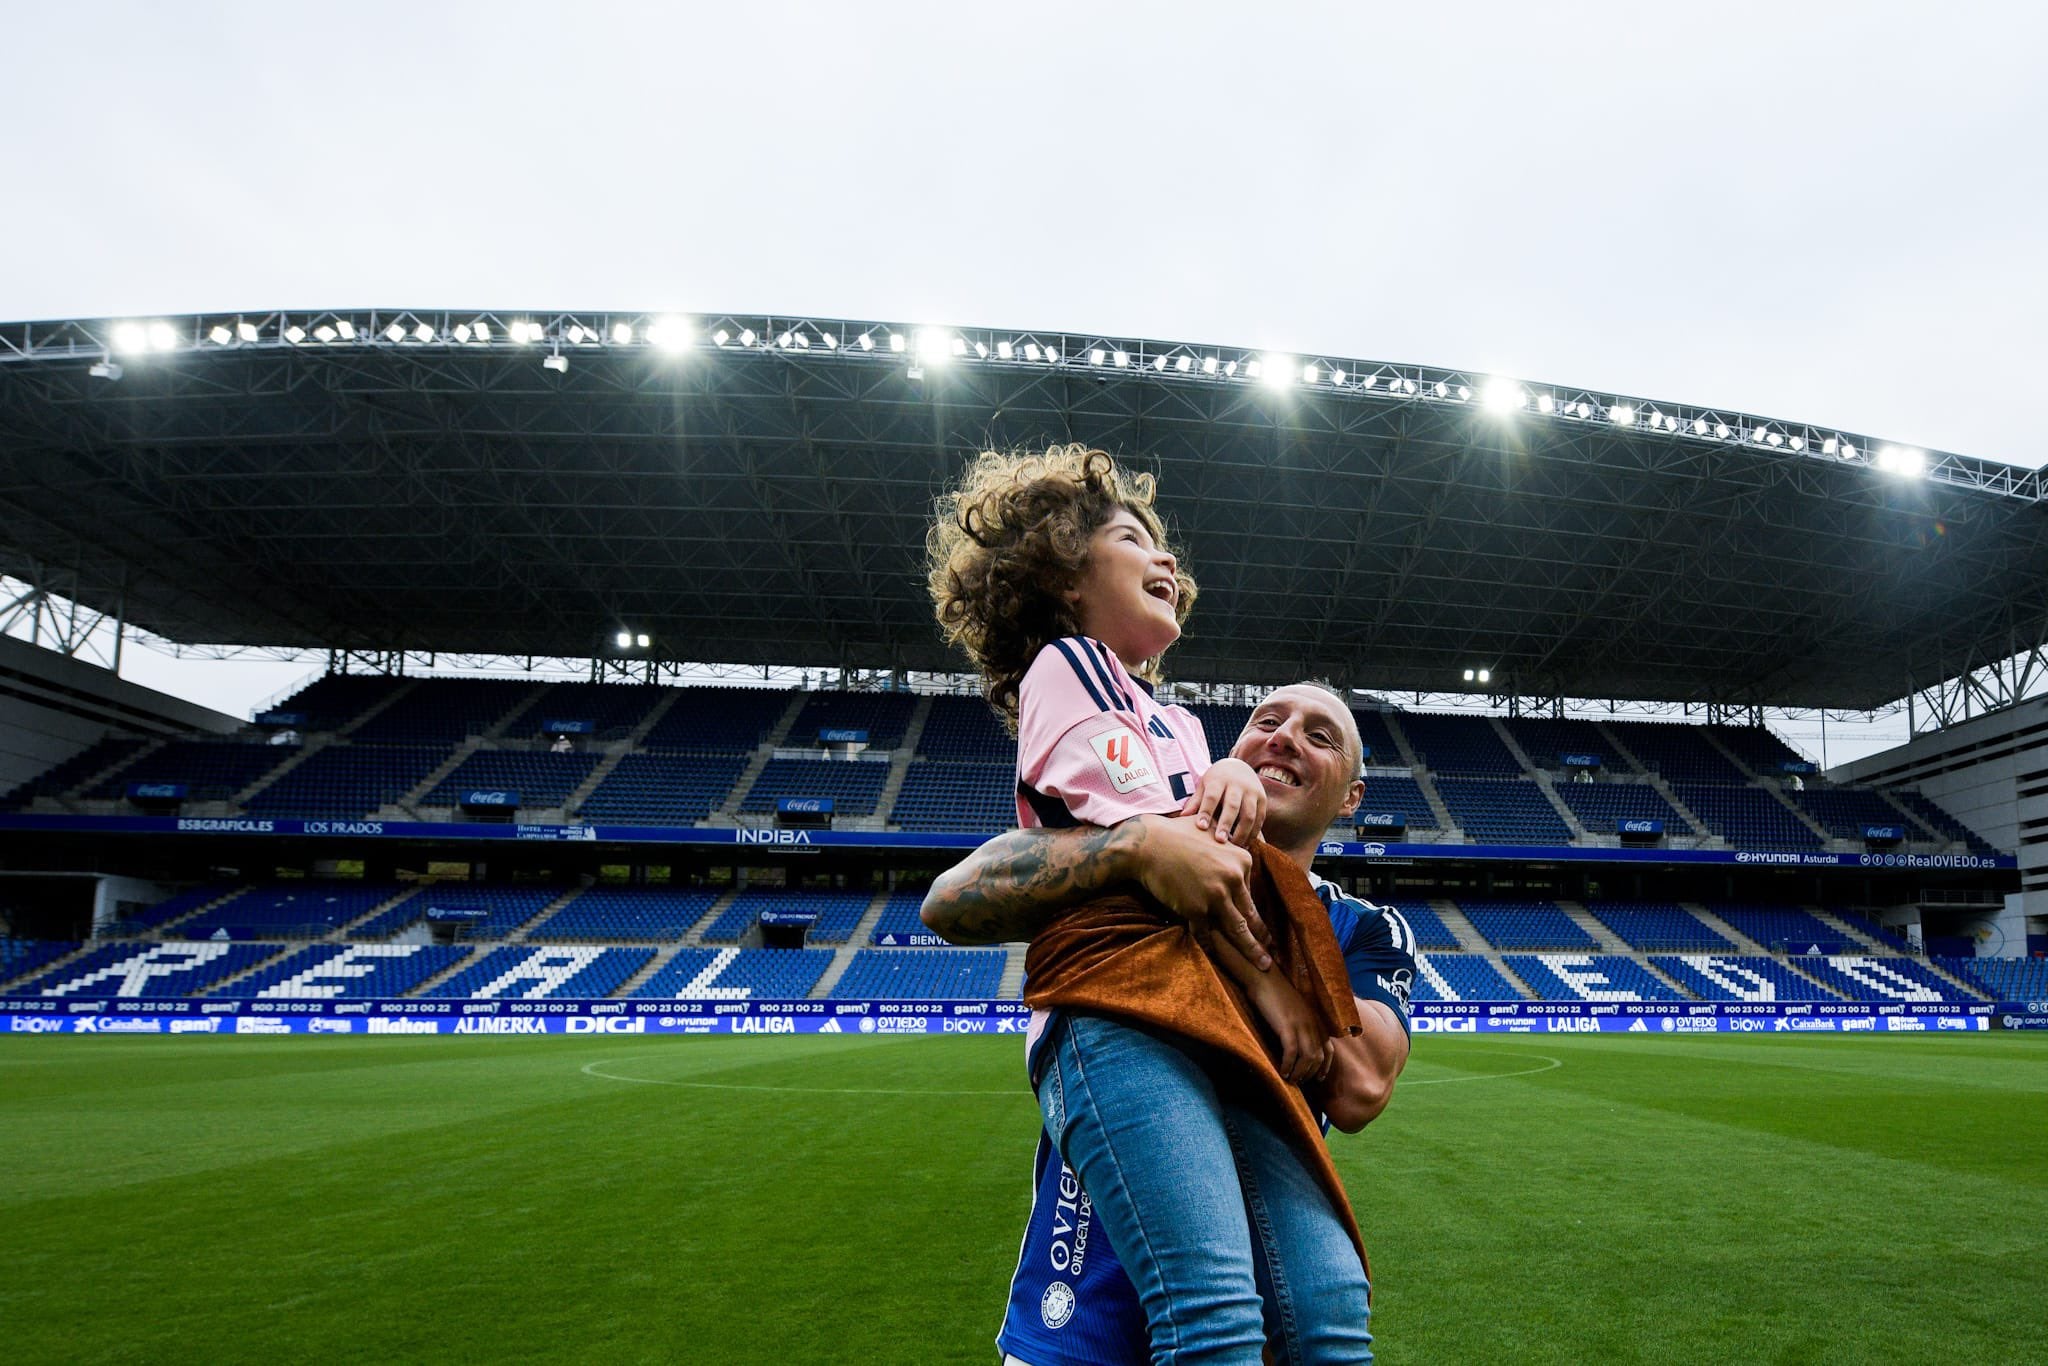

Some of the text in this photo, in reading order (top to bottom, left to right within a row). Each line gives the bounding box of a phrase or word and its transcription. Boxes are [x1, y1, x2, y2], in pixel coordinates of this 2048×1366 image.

[1117, 767, 1150, 785] LALIGA
[303, 821, 383, 834] LOS PRADOS
[736, 829, 811, 843] INDIBA
[1751, 853, 1839, 864] HYUNDAI Asturdai
[1907, 855, 1996, 868] RealOVIEDO.es
[8, 1002, 22, 1010] 23
[24, 1002, 39, 1010] 00
[42, 1002, 56, 1010] 22
[117, 1002, 140, 1012] 900
[142, 1002, 155, 1012] 23
[157, 1002, 173, 1012] 00
[175, 1002, 188, 1012] 22
[251, 1003, 274, 1013] 900
[276, 1003, 289, 1013] 23
[291, 1003, 307, 1013] 00
[309, 1003, 322, 1013] 22
[381, 1003, 403, 1013] 900
[405, 1003, 417, 1013] 23
[420, 1003, 435, 1013] 00
[438, 1003, 450, 1013] 22
[511, 1003, 532, 1013] 900
[534, 1003, 547, 1013] 23
[549, 1003, 564, 1013] 00
[566, 1003, 578, 1013] 22
[636, 1003, 657, 1013] 900
[659, 1003, 671, 1013] 23
[674, 1003, 688, 1013] 00
[690, 1003, 702, 1013] 22
[760, 1003, 779, 1013] 900
[782, 1003, 793, 1013] 23
[796, 1003, 810, 1013] 00
[812, 1003, 824, 1013] 22
[880, 1003, 899, 1013] 900
[902, 1003, 913, 1013] 23
[915, 1003, 929, 1013] 00
[931, 1003, 942, 1013] 22
[996, 1004, 1015, 1013] 900
[1424, 1005, 1441, 1015] 900
[1443, 1005, 1453, 1015] 23
[1455, 1005, 1467, 1015] 00
[1469, 1005, 1479, 1015] 22
[1527, 1005, 1544, 1015] 900
[1546, 1005, 1555, 1015] 23
[1557, 1005, 1569, 1015] 00
[1571, 1005, 1581, 1015] 22
[1627, 1005, 1643, 1015] 900
[1645, 1005, 1654, 1015] 23
[1657, 1005, 1668, 1015] 00
[1670, 1005, 1679, 1015] 22
[1724, 1005, 1741, 1015] 900
[1743, 1005, 1752, 1015] 23
[1753, 1005, 1765, 1015] 00
[1766, 1005, 1776, 1015] 22
[1820, 1005, 1836, 1015] 900
[1838, 1005, 1847, 1015] 23
[1848, 1005, 1859, 1015] 00
[1861, 1005, 1870, 1015] 22
[1911, 1005, 1927, 1015] 900
[1929, 1005, 1938, 1015] 23
[1939, 1005, 1949, 1015] 00
[1951, 1005, 1960, 1015] 22
[367, 1016, 438, 1033] Mahou
[454, 1017, 547, 1033] ALIMERKA
[566, 1017, 645, 1033] DIGI
[731, 1017, 795, 1033] LALIGA
[877, 1017, 928, 1028] OVIEDO
[1410, 1017, 1476, 1032] DIGI
[1547, 1017, 1600, 1032] LALIGA
[1676, 1017, 1717, 1027] OVIEDO
[1791, 1017, 1836, 1029] CaixaBank
[1070, 1219, 1090, 1276] ORIGEN
